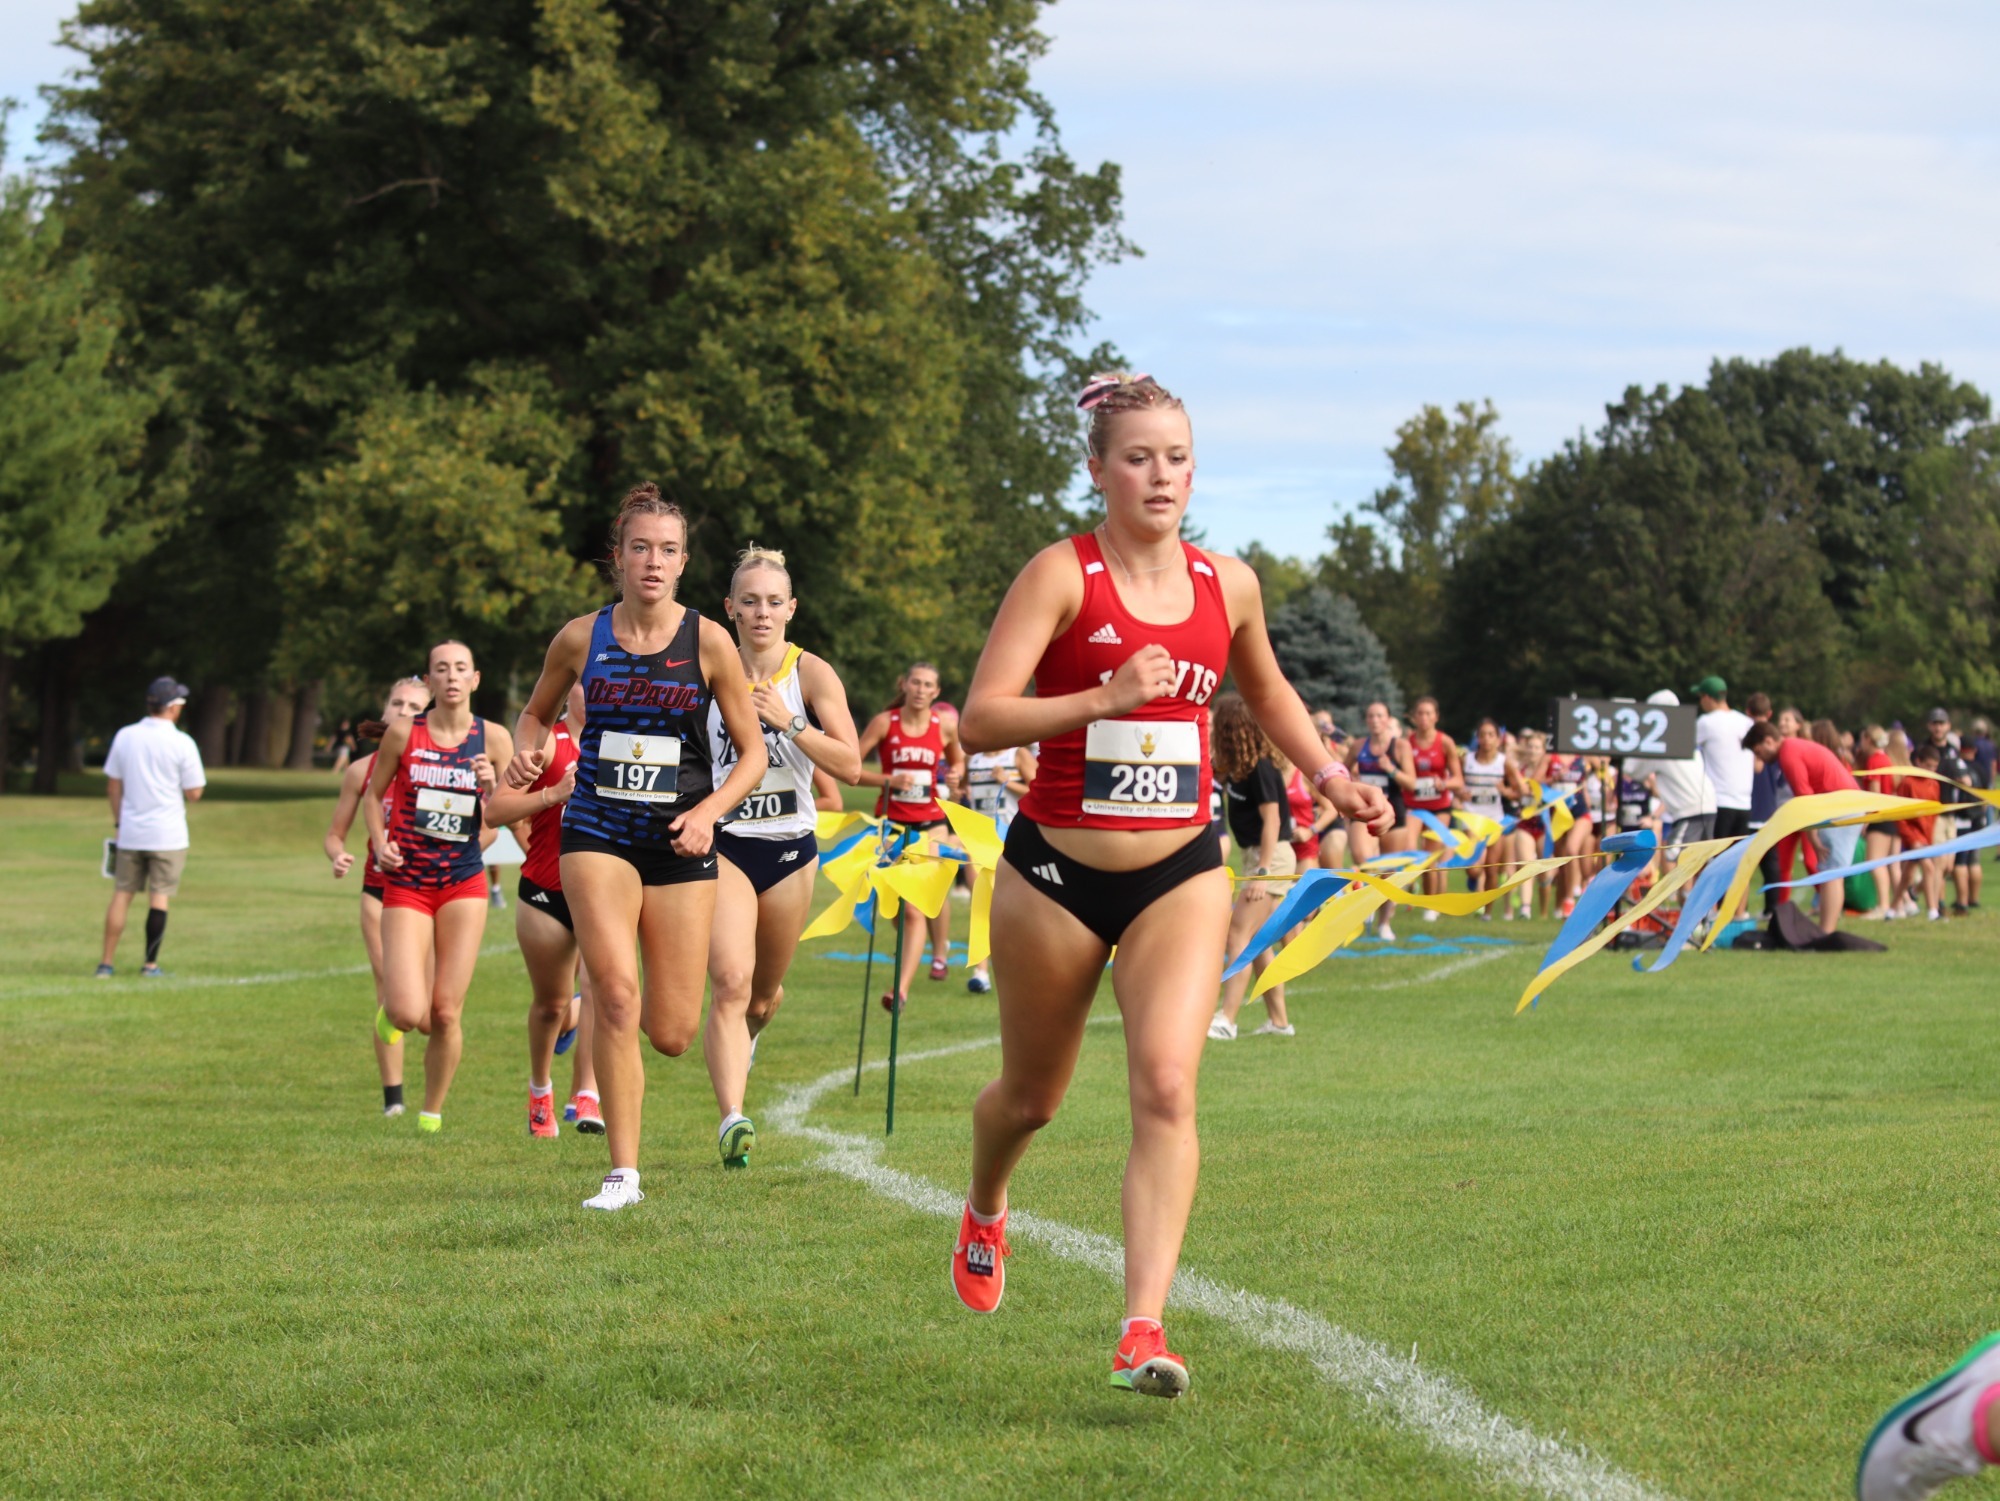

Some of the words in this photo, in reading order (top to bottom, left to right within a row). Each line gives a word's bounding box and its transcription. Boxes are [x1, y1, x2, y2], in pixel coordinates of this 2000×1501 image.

[1088, 635, 1122, 645] adidas
[1570, 704, 1669, 754] 3:32
[891, 746, 936, 766] LEWIS
[409, 763, 477, 790] DUQUESNE
[613, 762, 662, 791] 197
[1109, 764, 1178, 803] 289
[603, 789, 628, 797] University
[739, 794, 782, 820] 370
[1093, 803, 1134, 813] University
[426, 811, 462, 834] 243
